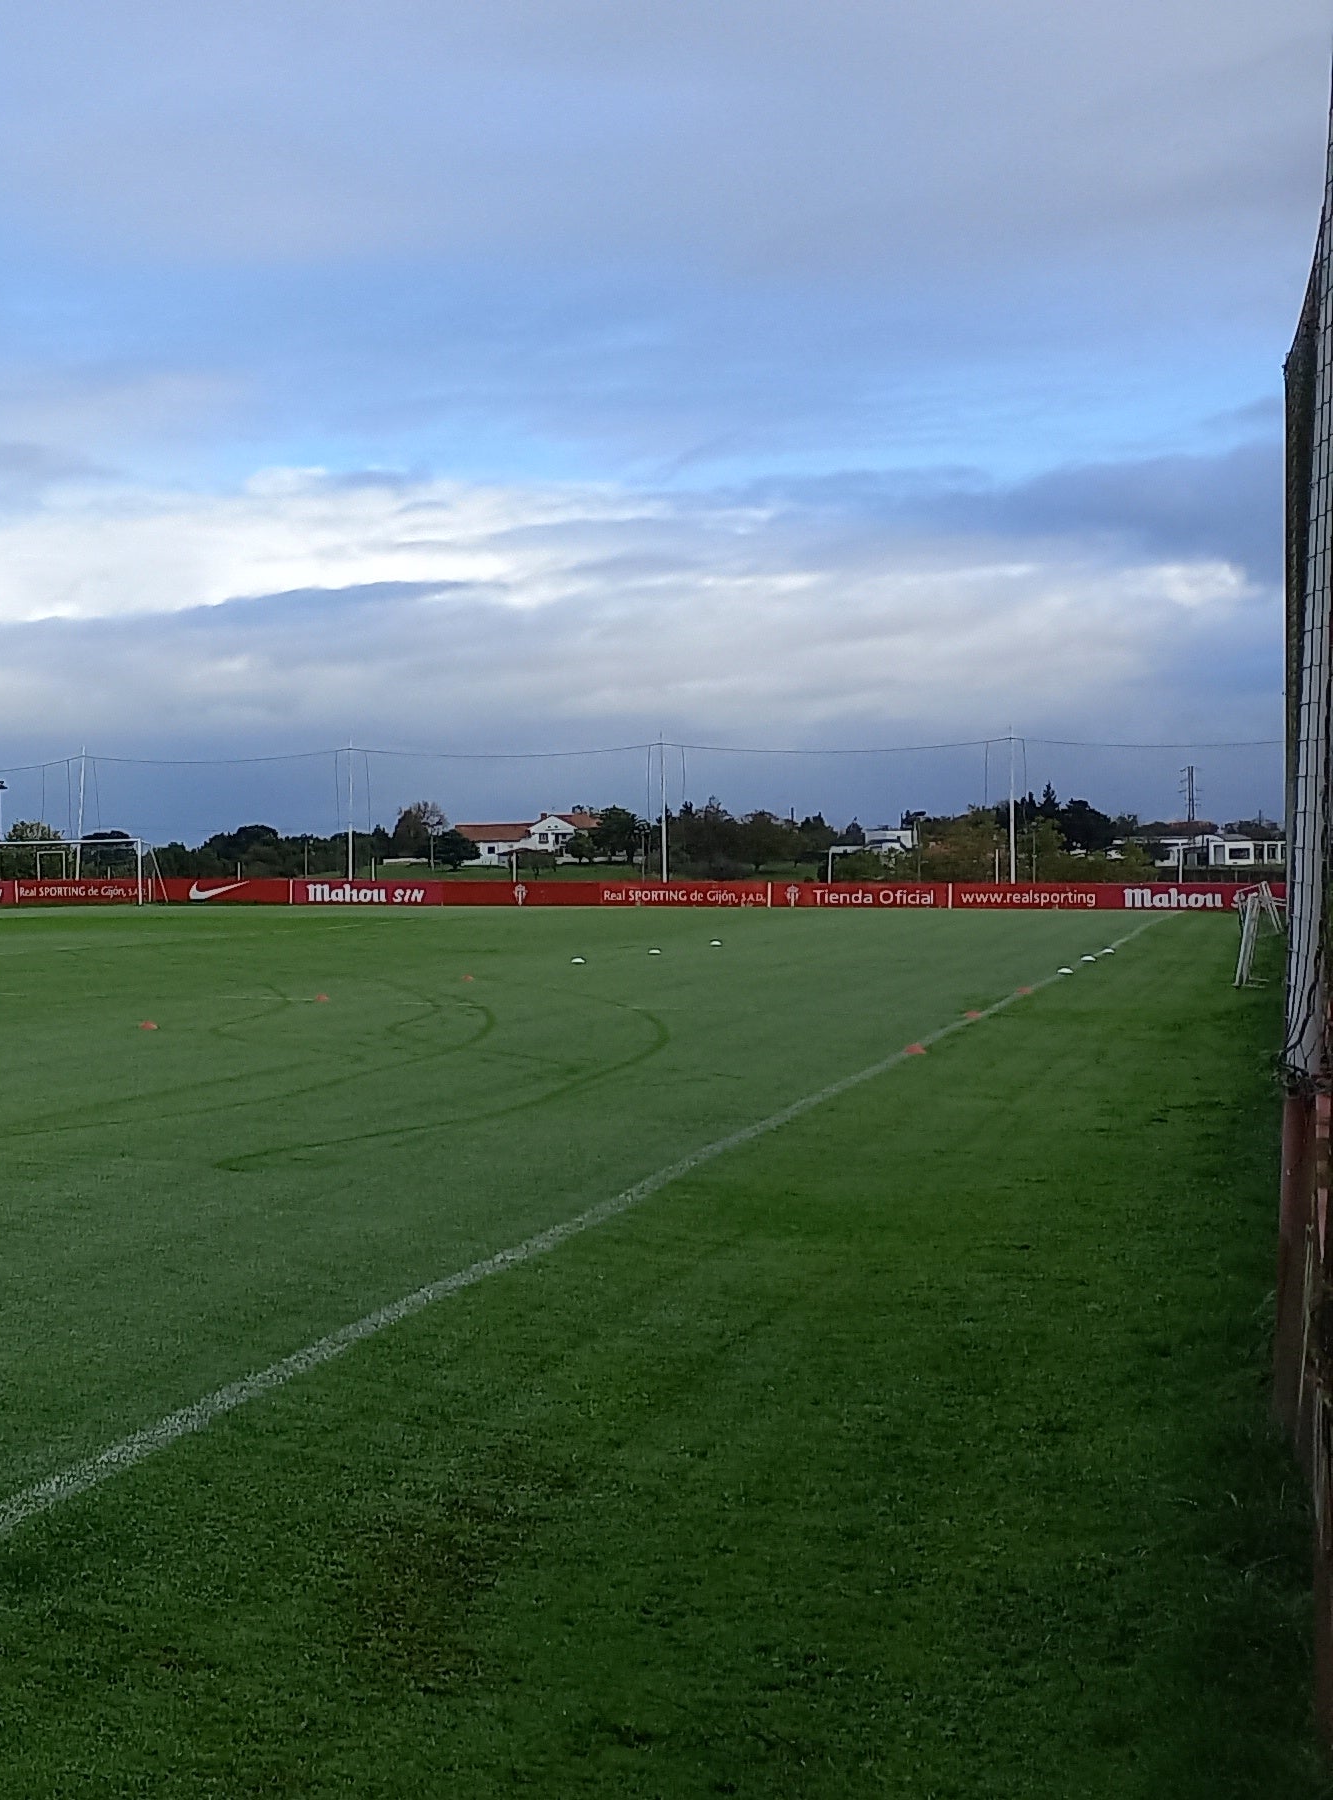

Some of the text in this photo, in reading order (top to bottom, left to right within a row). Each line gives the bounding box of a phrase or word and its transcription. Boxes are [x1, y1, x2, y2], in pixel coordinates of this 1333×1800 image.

[20, 886, 36, 897] Real
[38, 886, 85, 897] SPORTING
[87, 886, 99, 897] de
[306, 884, 425, 903] Mahou SIN
[603, 889, 626, 901] Real
[629, 889, 687, 902] SPORTING
[690, 889, 704, 902] de
[812, 889, 934, 905] Tienda Oficial
[961, 890, 1096, 907] www.realsporting
[1123, 888, 1223, 908] Mahou
